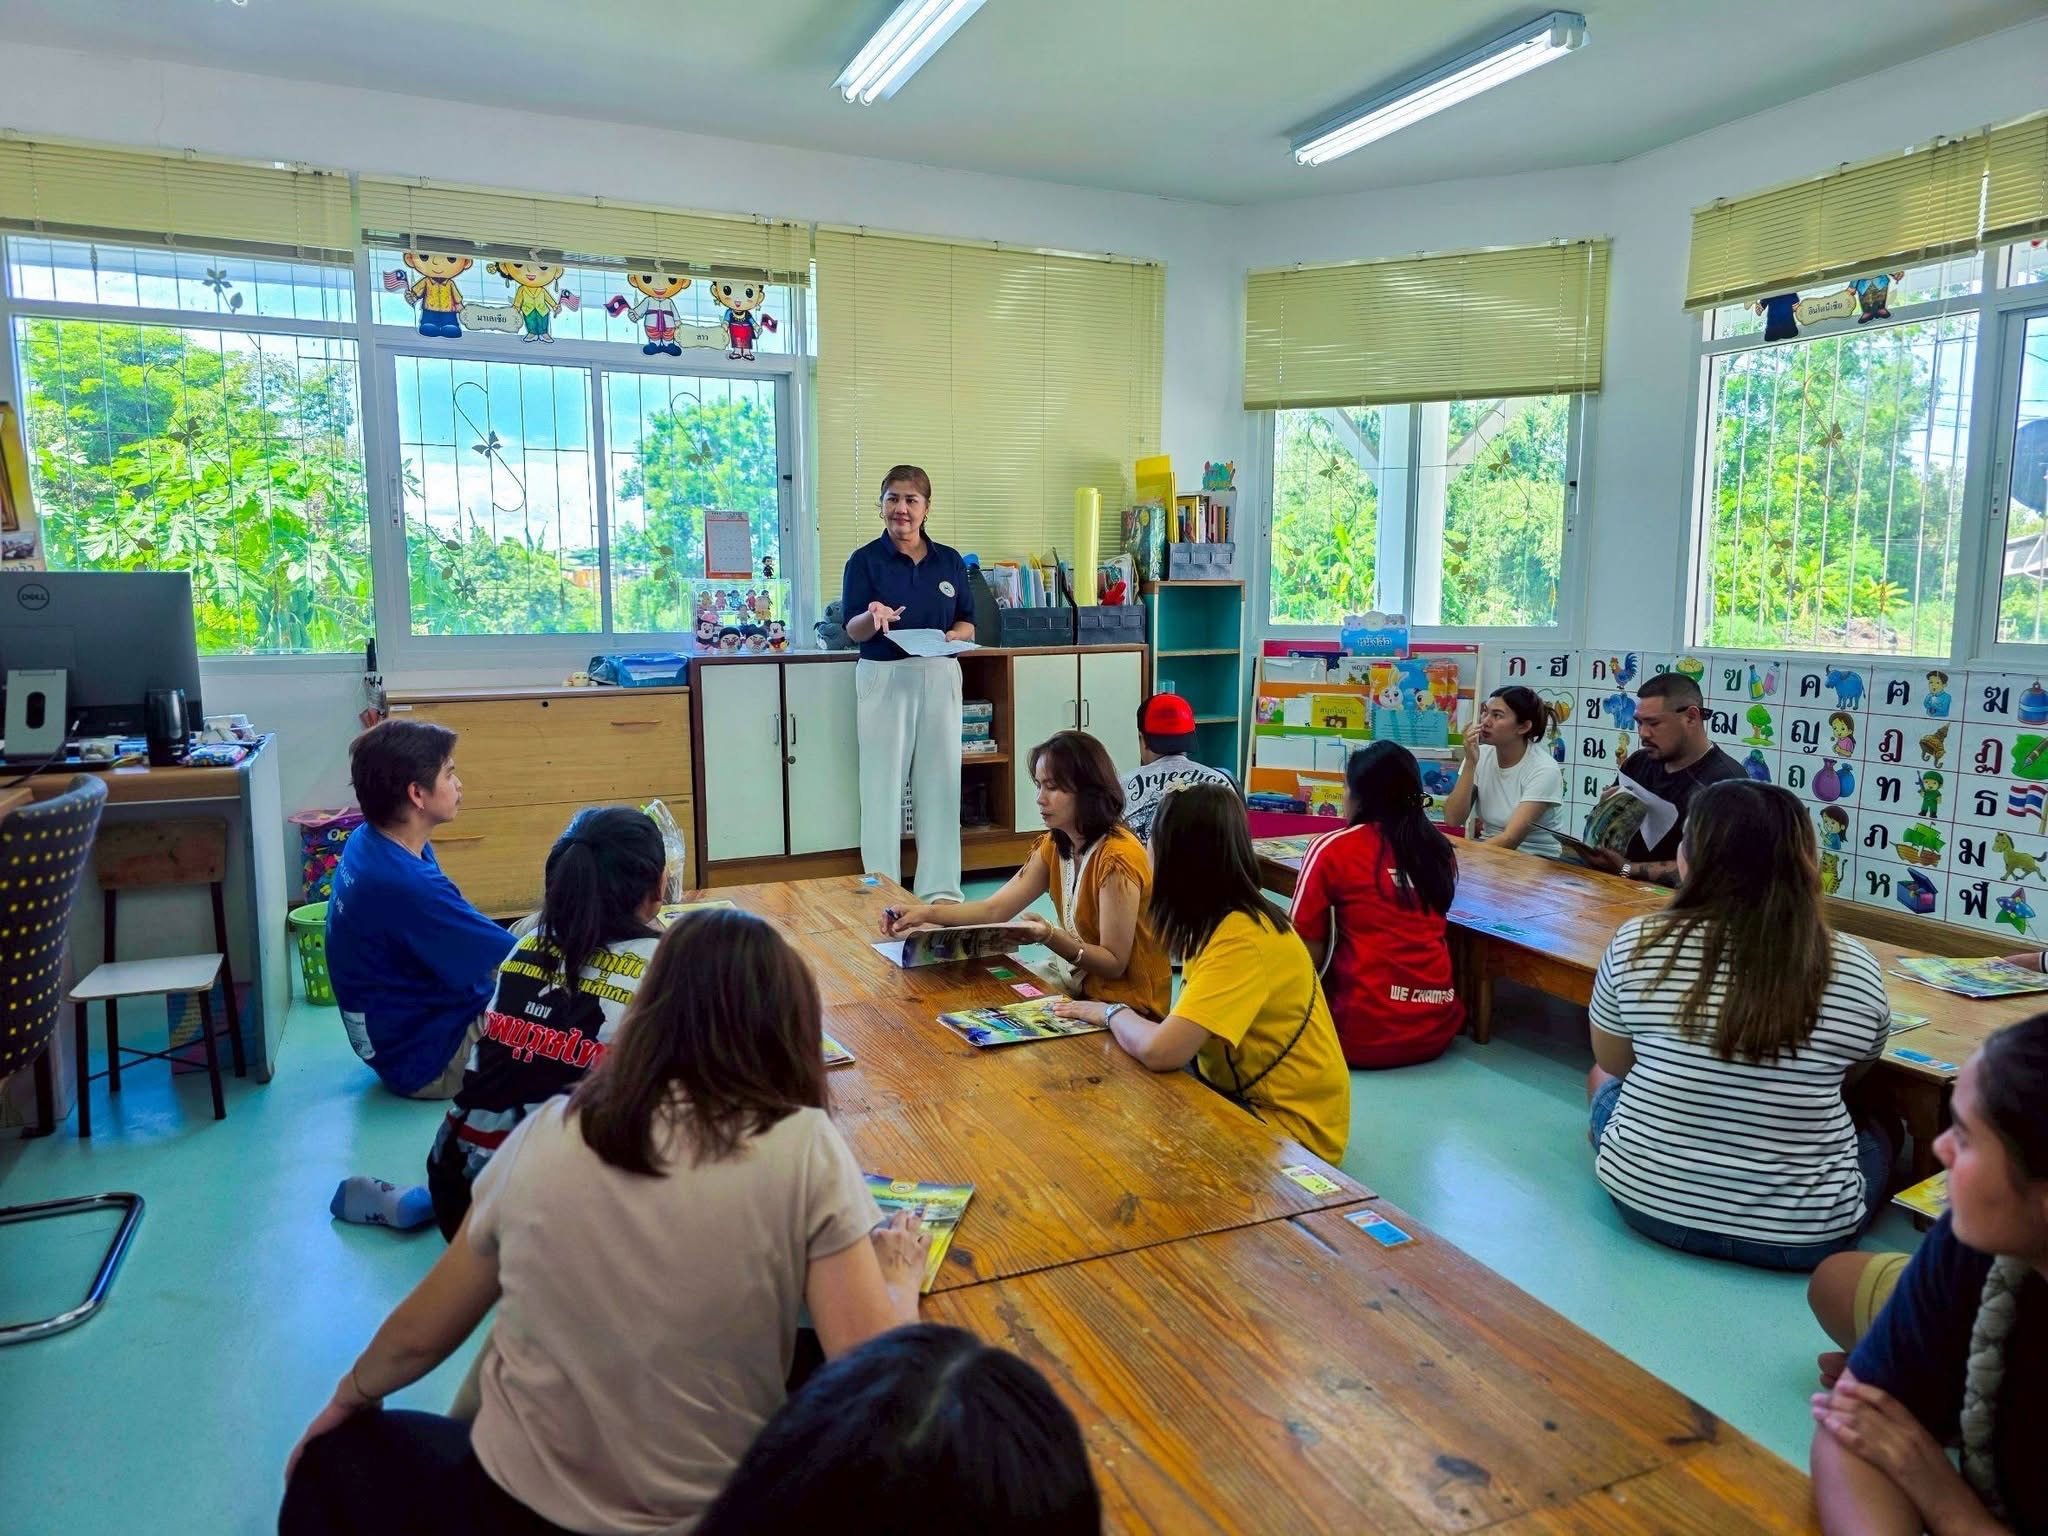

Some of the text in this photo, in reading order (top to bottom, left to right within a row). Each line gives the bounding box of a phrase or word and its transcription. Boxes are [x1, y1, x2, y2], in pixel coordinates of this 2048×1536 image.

[1508, 656, 1527, 677] ก
[1550, 654, 1571, 677] ฮ
[1592, 659, 1607, 680] ก
[1800, 674, 1822, 699] ค
[1886, 679, 1911, 706] ฅ
[1586, 697, 1601, 720] ช
[1982, 685, 2011, 715] ฆ
[1582, 736, 1607, 760] ณ
[1790, 719, 1821, 754] ญ
[1583, 775, 1598, 798] ผ
[1787, 764, 1806, 789] ถ
[1876, 776, 1902, 803] ท
[1973, 789, 1999, 817] ธ
[1863, 824, 1889, 850] ภ
[1958, 837, 1987, 868] ม
[1865, 870, 1891, 898] ห
[1959, 881, 1990, 919] ฬ
[1390, 985, 1409, 1001] WE
[524, 1000, 553, 1020] ของ
